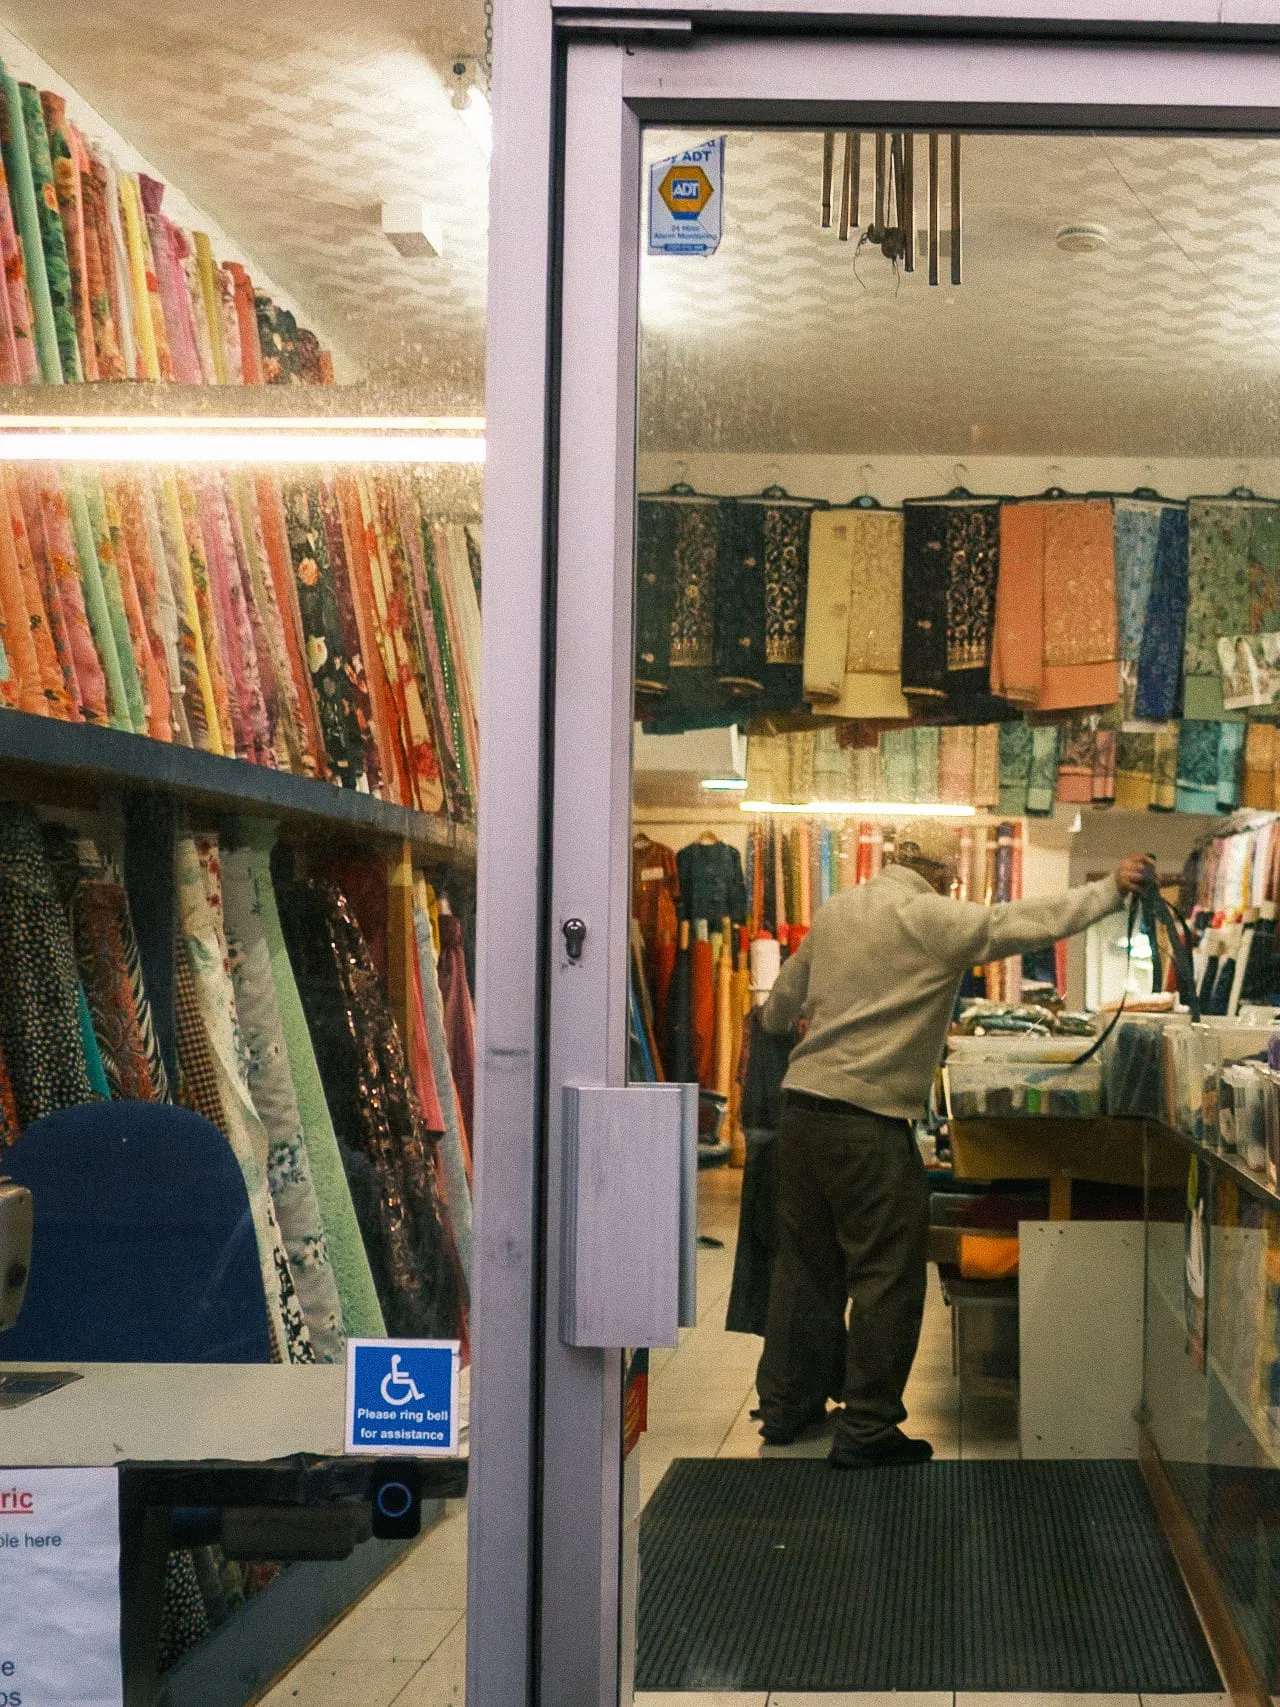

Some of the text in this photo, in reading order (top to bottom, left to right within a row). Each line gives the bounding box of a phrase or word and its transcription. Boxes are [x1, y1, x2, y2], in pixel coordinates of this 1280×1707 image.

[682, 151, 712, 161] ADT
[673, 182, 698, 197] ADT
[357, 1408, 448, 1423] Please ring bell
[360, 1428, 444, 1441] for assistance
[0, 1487, 34, 1509] ric
[25, 1532, 62, 1548] here
